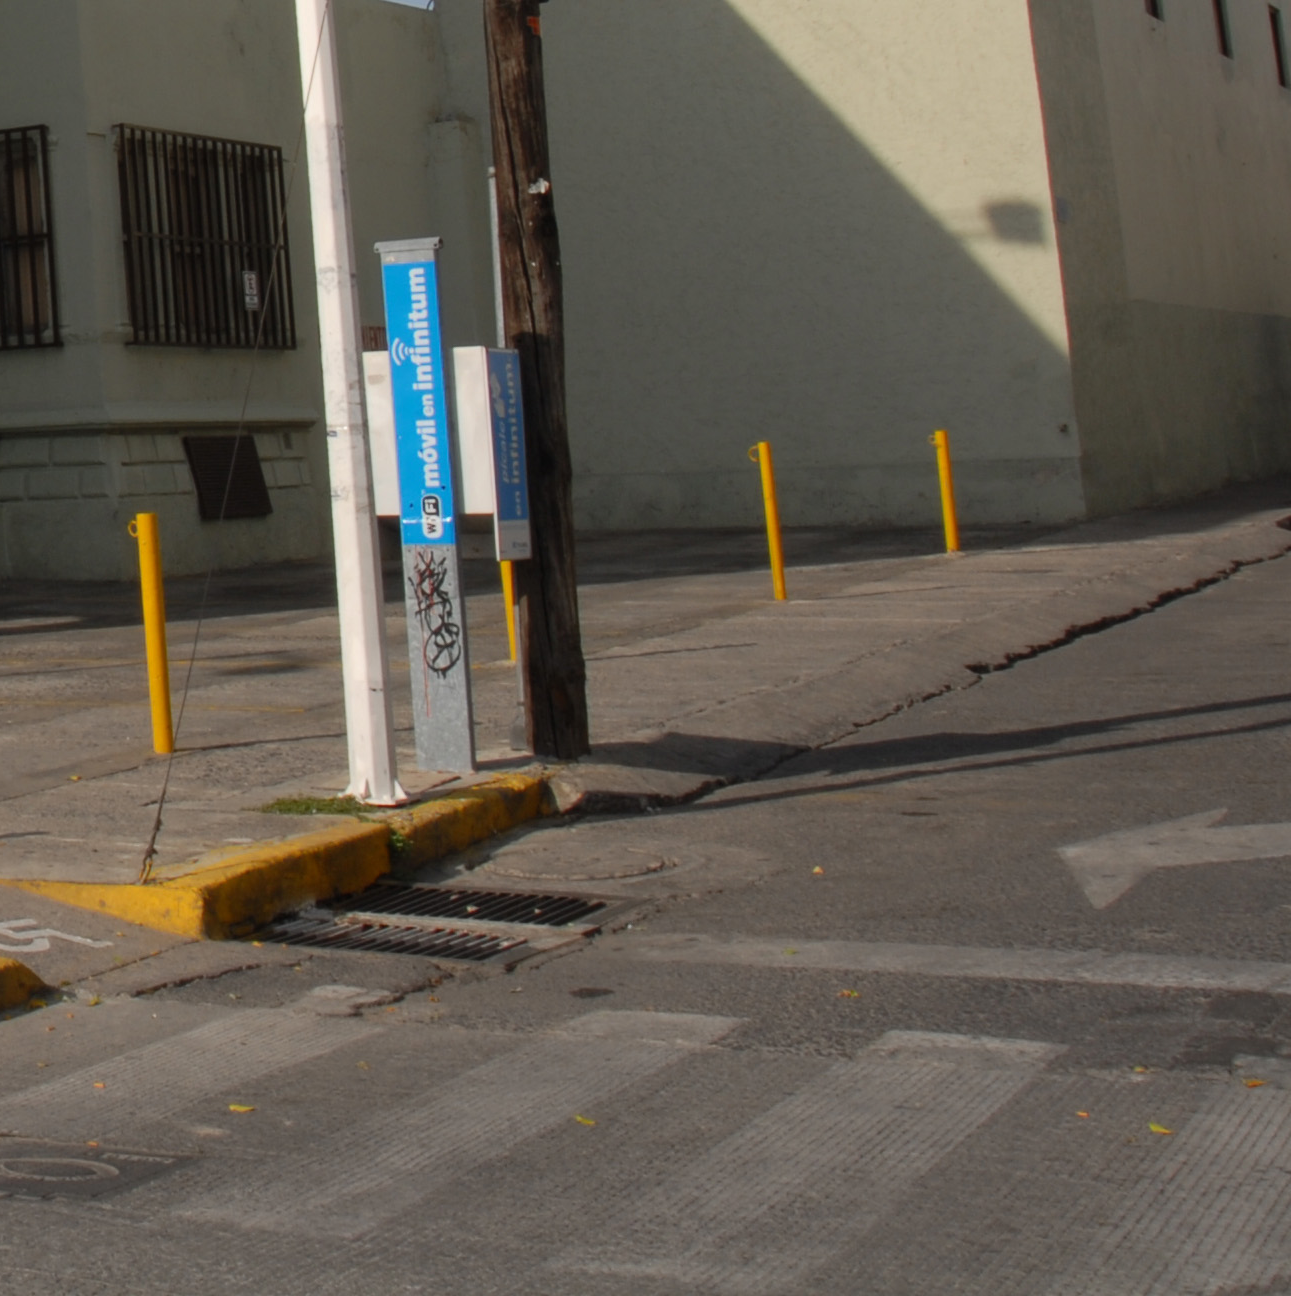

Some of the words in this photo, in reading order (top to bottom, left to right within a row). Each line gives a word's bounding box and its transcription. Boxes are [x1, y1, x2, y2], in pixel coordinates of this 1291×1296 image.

[407, 268, 434, 390] infinitum
[422, 394, 435, 417] en
[416, 420, 440, 488] móvil
